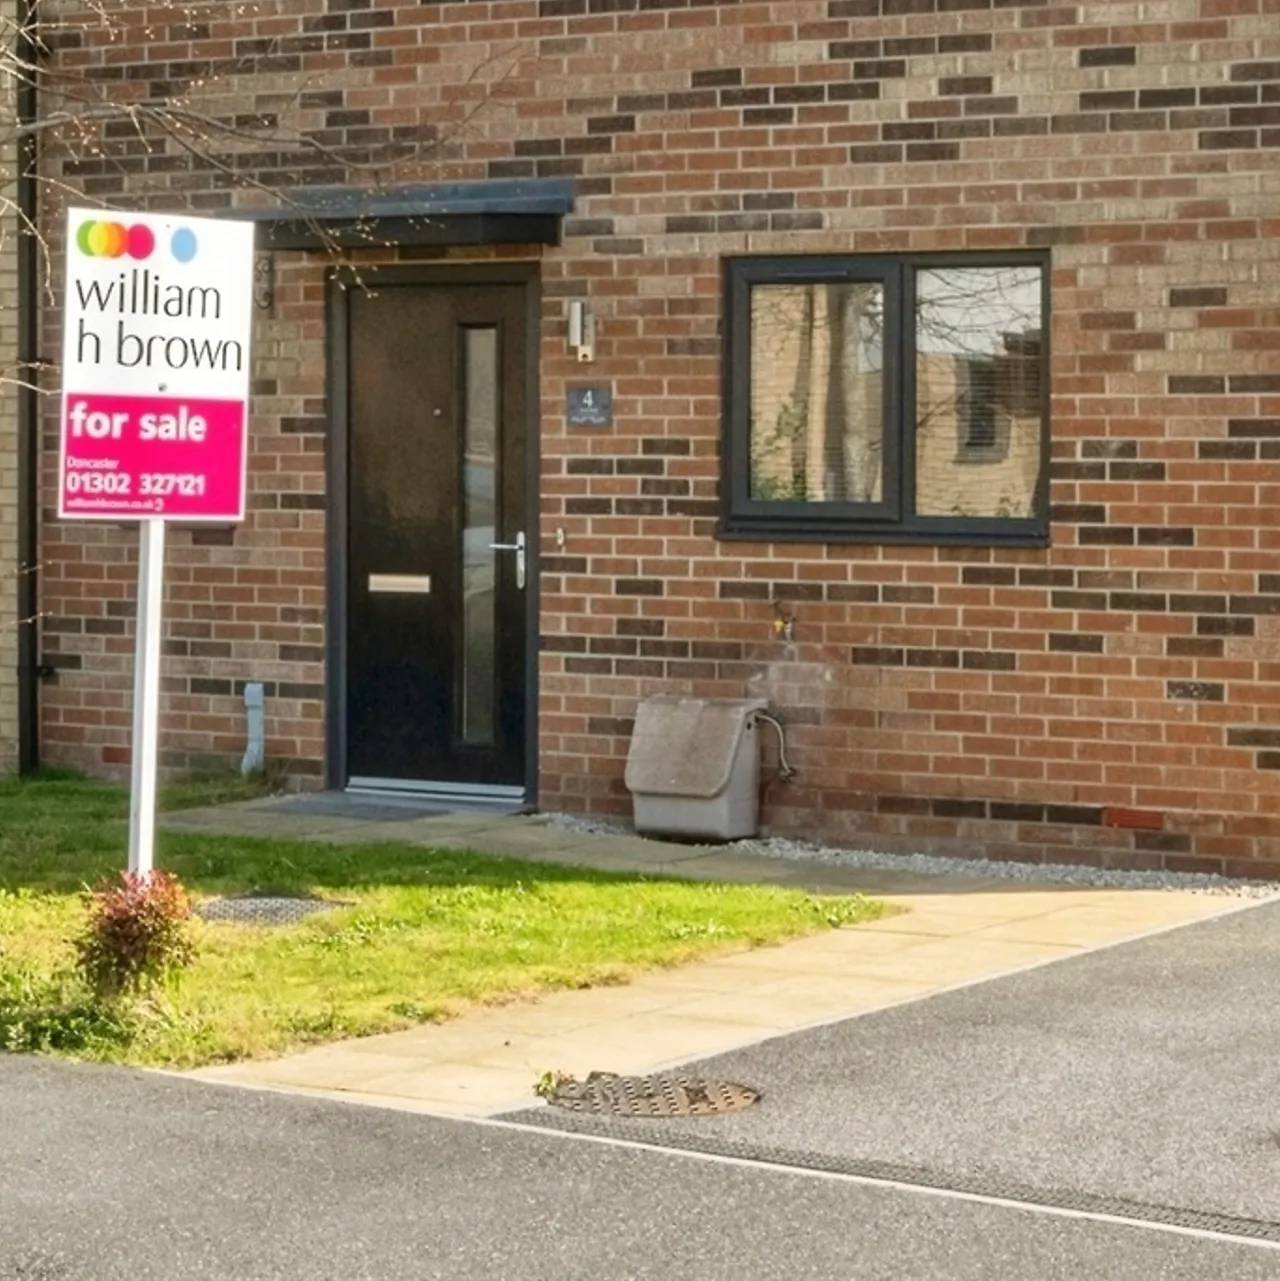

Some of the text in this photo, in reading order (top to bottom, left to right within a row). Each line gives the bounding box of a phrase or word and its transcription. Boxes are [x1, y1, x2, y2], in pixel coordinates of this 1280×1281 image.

[75, 268, 221, 319] william
[77, 317, 242, 371] h brown
[582, 389, 594, 407] 4
[70, 401, 207, 442] for sale
[66, 472, 207, 497] 01302 327121
